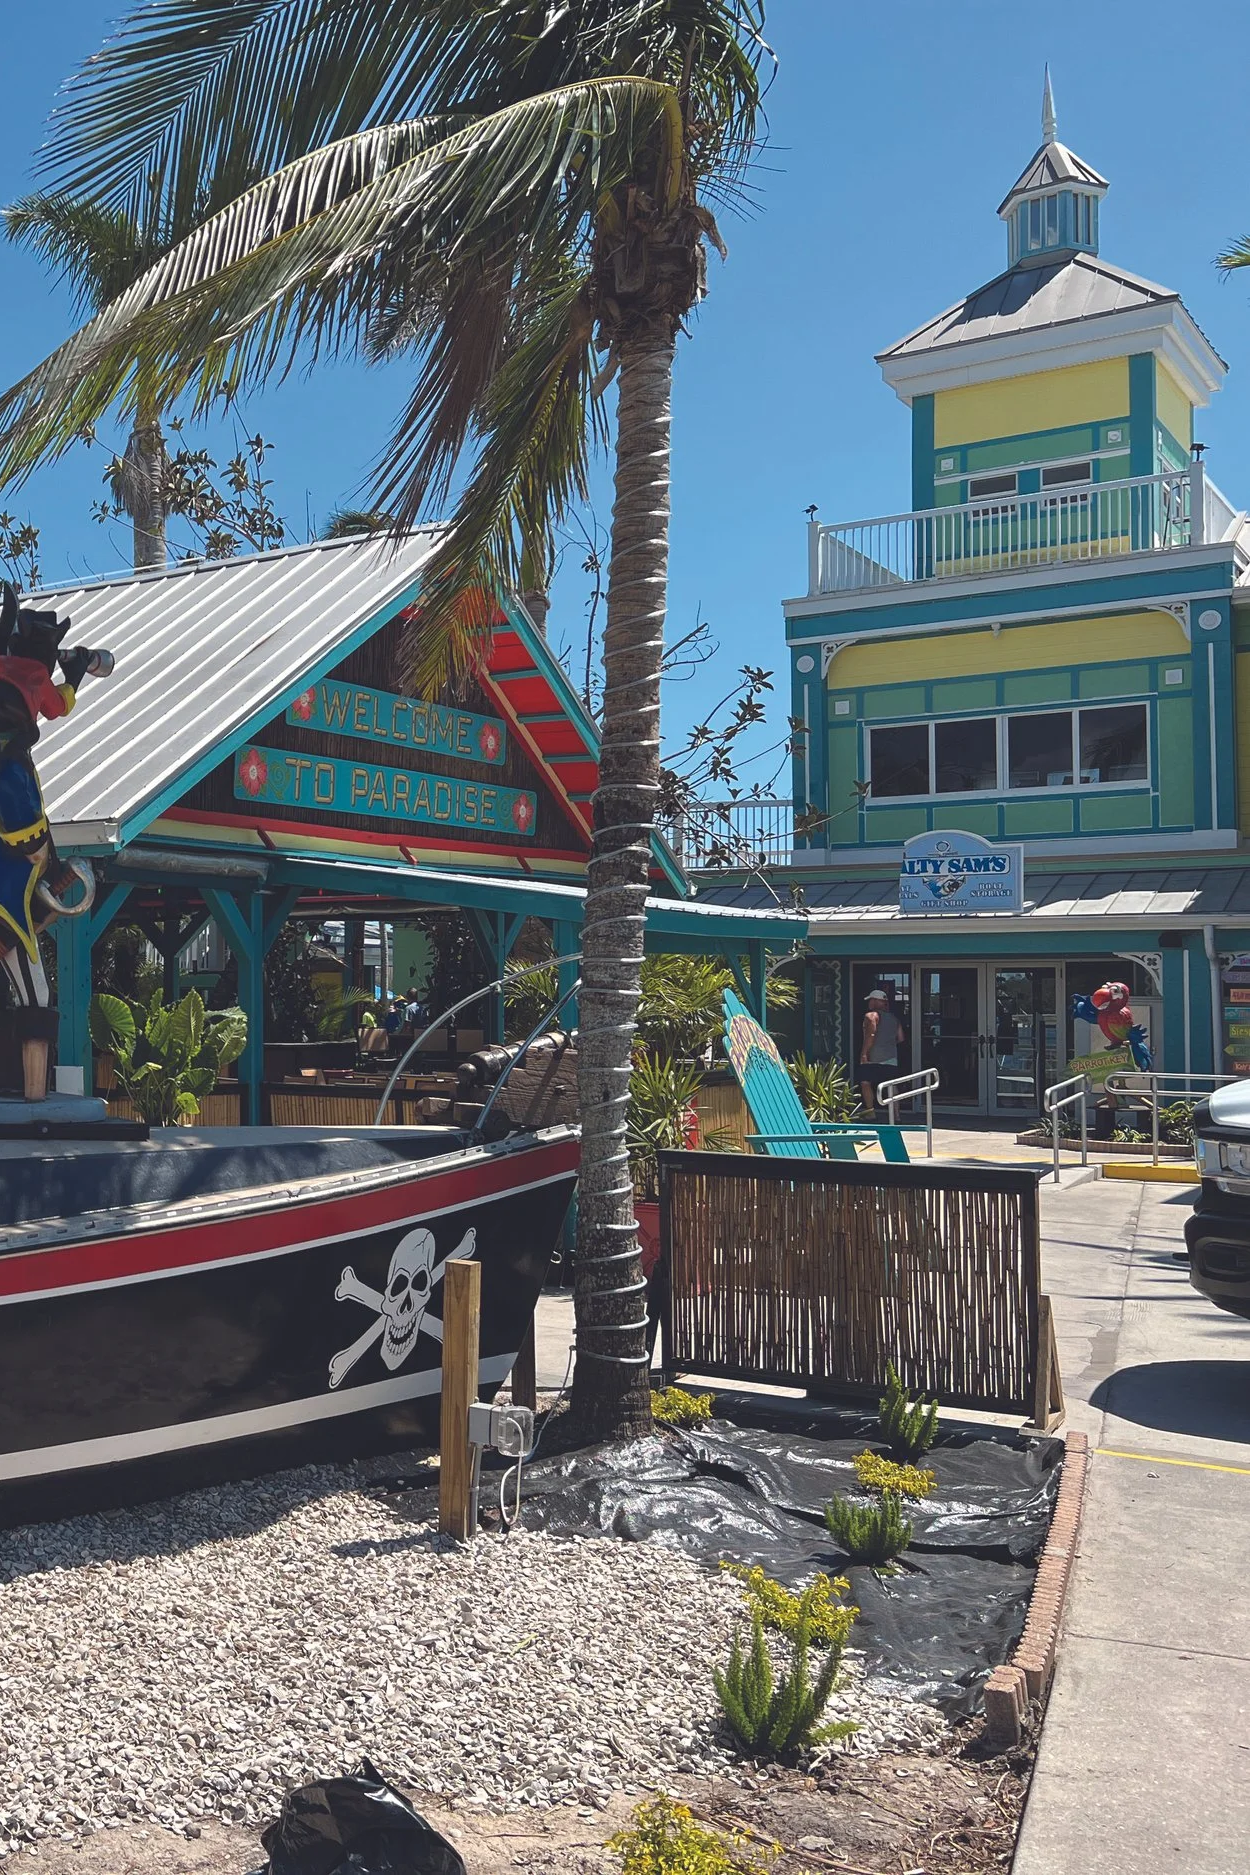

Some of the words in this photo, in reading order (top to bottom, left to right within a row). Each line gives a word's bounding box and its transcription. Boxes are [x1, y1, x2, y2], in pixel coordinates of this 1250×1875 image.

[321, 684, 472, 754] WELCOME
[285, 757, 335, 804] TO
[351, 767, 497, 825] PARADISE
[902, 858, 944, 875] ALTY
[948, 856, 1006, 873] SAM'S
[1110, 1053, 1128, 1064] KEY
